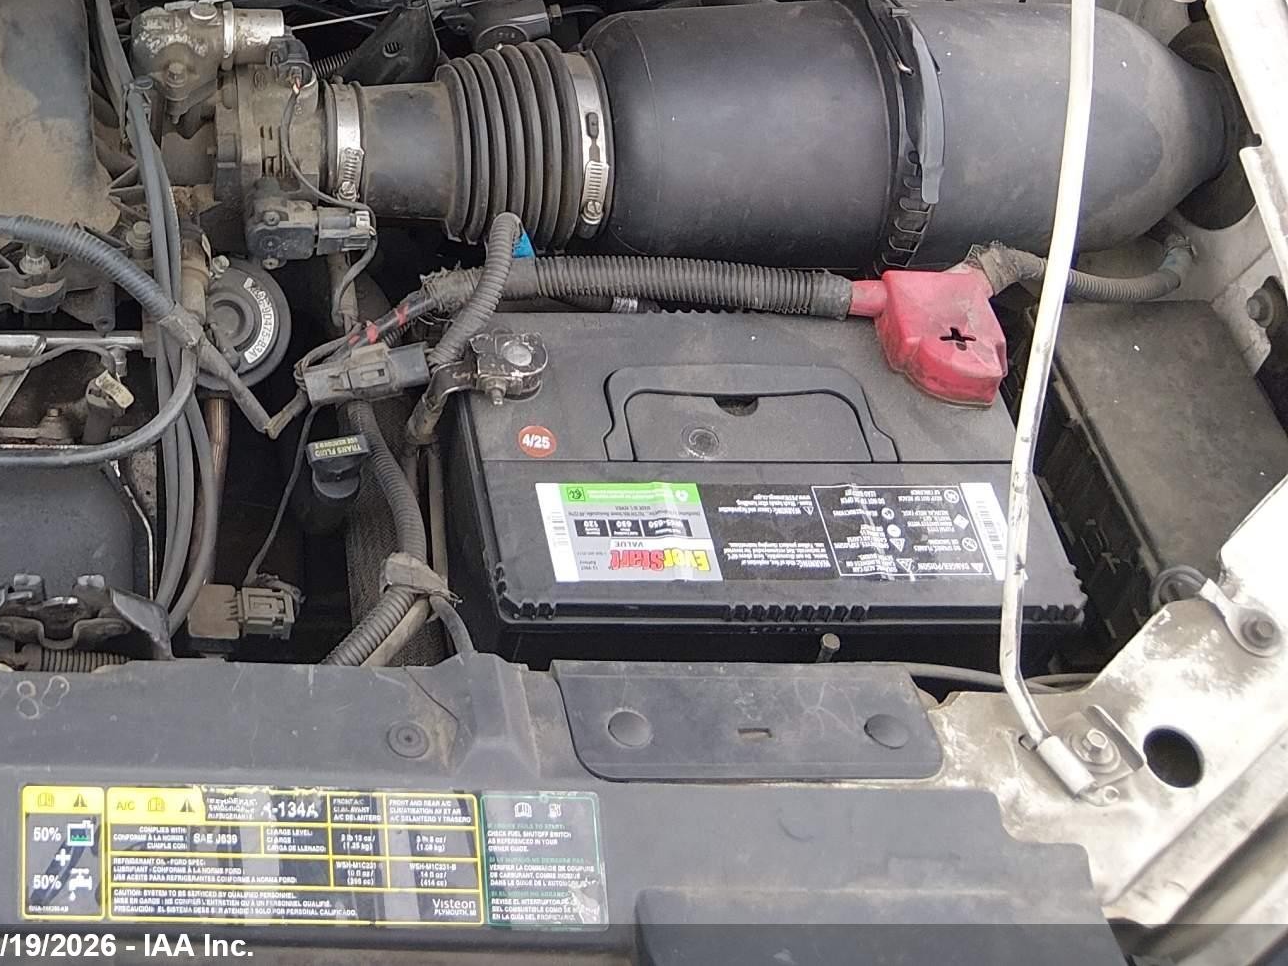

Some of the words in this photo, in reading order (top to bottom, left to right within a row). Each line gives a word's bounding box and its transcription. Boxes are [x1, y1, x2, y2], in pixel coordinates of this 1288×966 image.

[521, 434, 551, 451] 4/25
[314, 448, 337, 457] FLUID
[336, 444, 362, 454] TRANS
[584, 520, 598, 528] 120
[616, 520, 633, 528] 630
[609, 548, 711, 572] EverStart
[116, 801, 136, 811] A/C
[33, 827, 62, 842] 50%
[139, 826, 170, 834] COMPLIES
[193, 833, 213, 844] SAE
[215, 834, 238, 845] J639
[146, 842, 172, 850] CUMPLE
[361, 842, 373, 851] kg)
[434, 844, 445, 853] kg)
[113, 865, 148, 873] LUBRIFIANT
[153, 866, 186, 874] CONFORME
[33, 875, 62, 890] 50%
[149, 874, 166, 882] PARA
[432, 898, 476, 909] Visteon
[166, 906, 193, 914] SISTEMA
